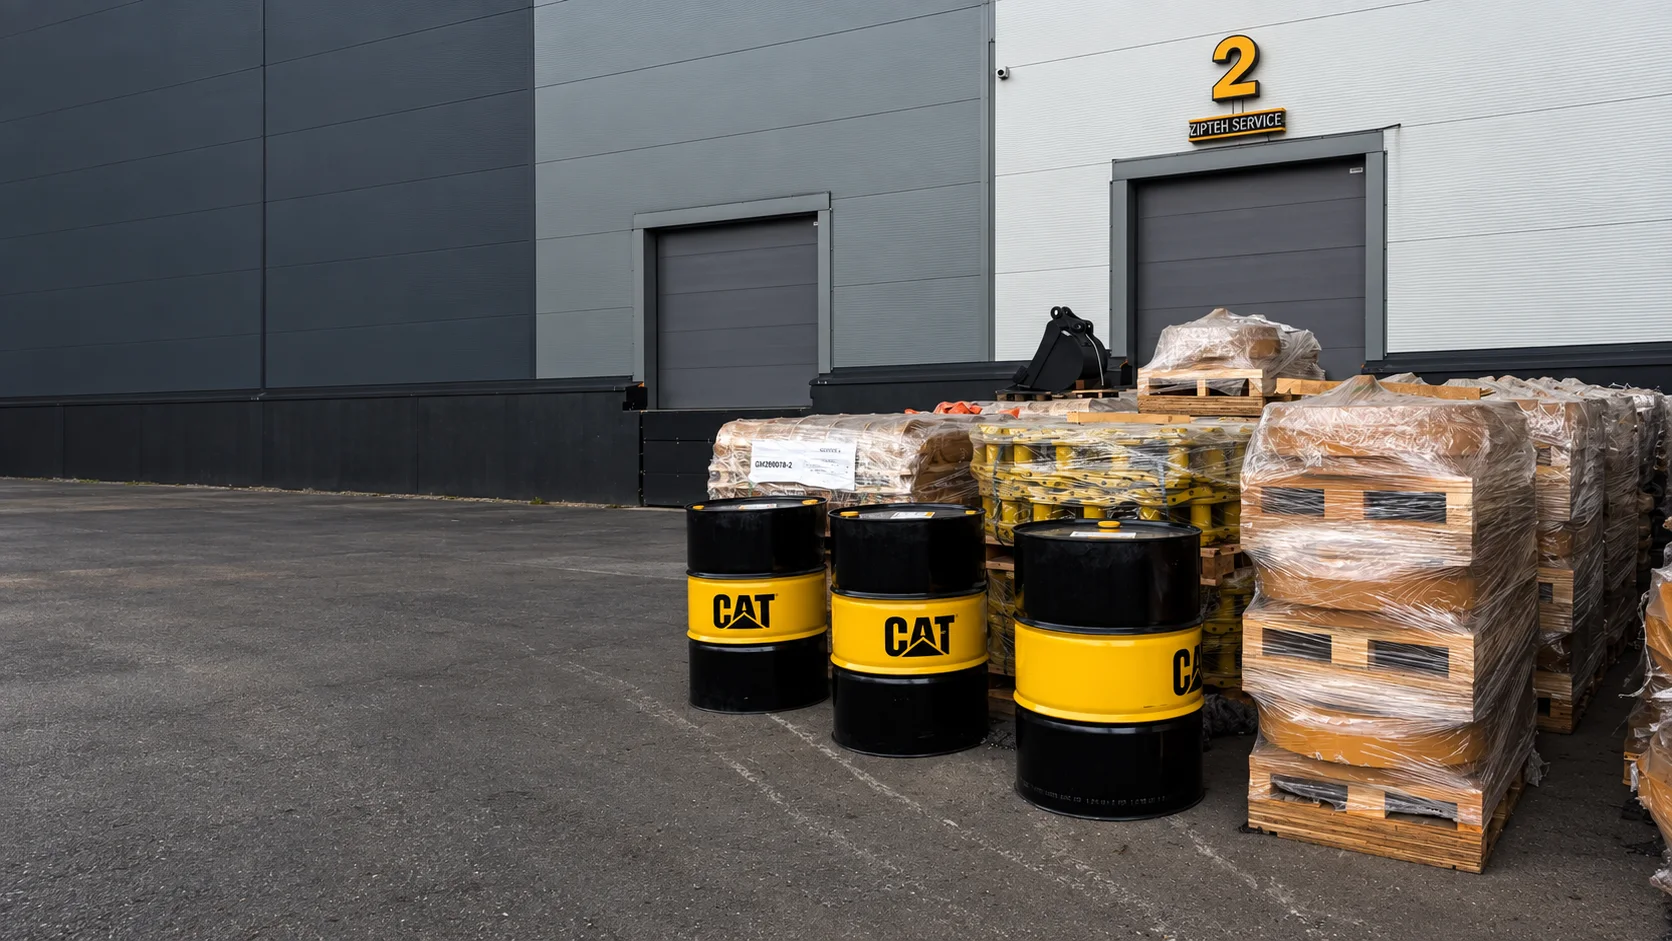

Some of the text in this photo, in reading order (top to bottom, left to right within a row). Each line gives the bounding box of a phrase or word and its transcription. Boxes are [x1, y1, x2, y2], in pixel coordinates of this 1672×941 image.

[1212, 34, 1260, 101] 2
[1190, 113, 1282, 136] ZIPTEH SERVICE
[713, 593, 775, 630] CAT
[884, 614, 955, 658] CAT
[1173, 644, 1203, 696] CA
